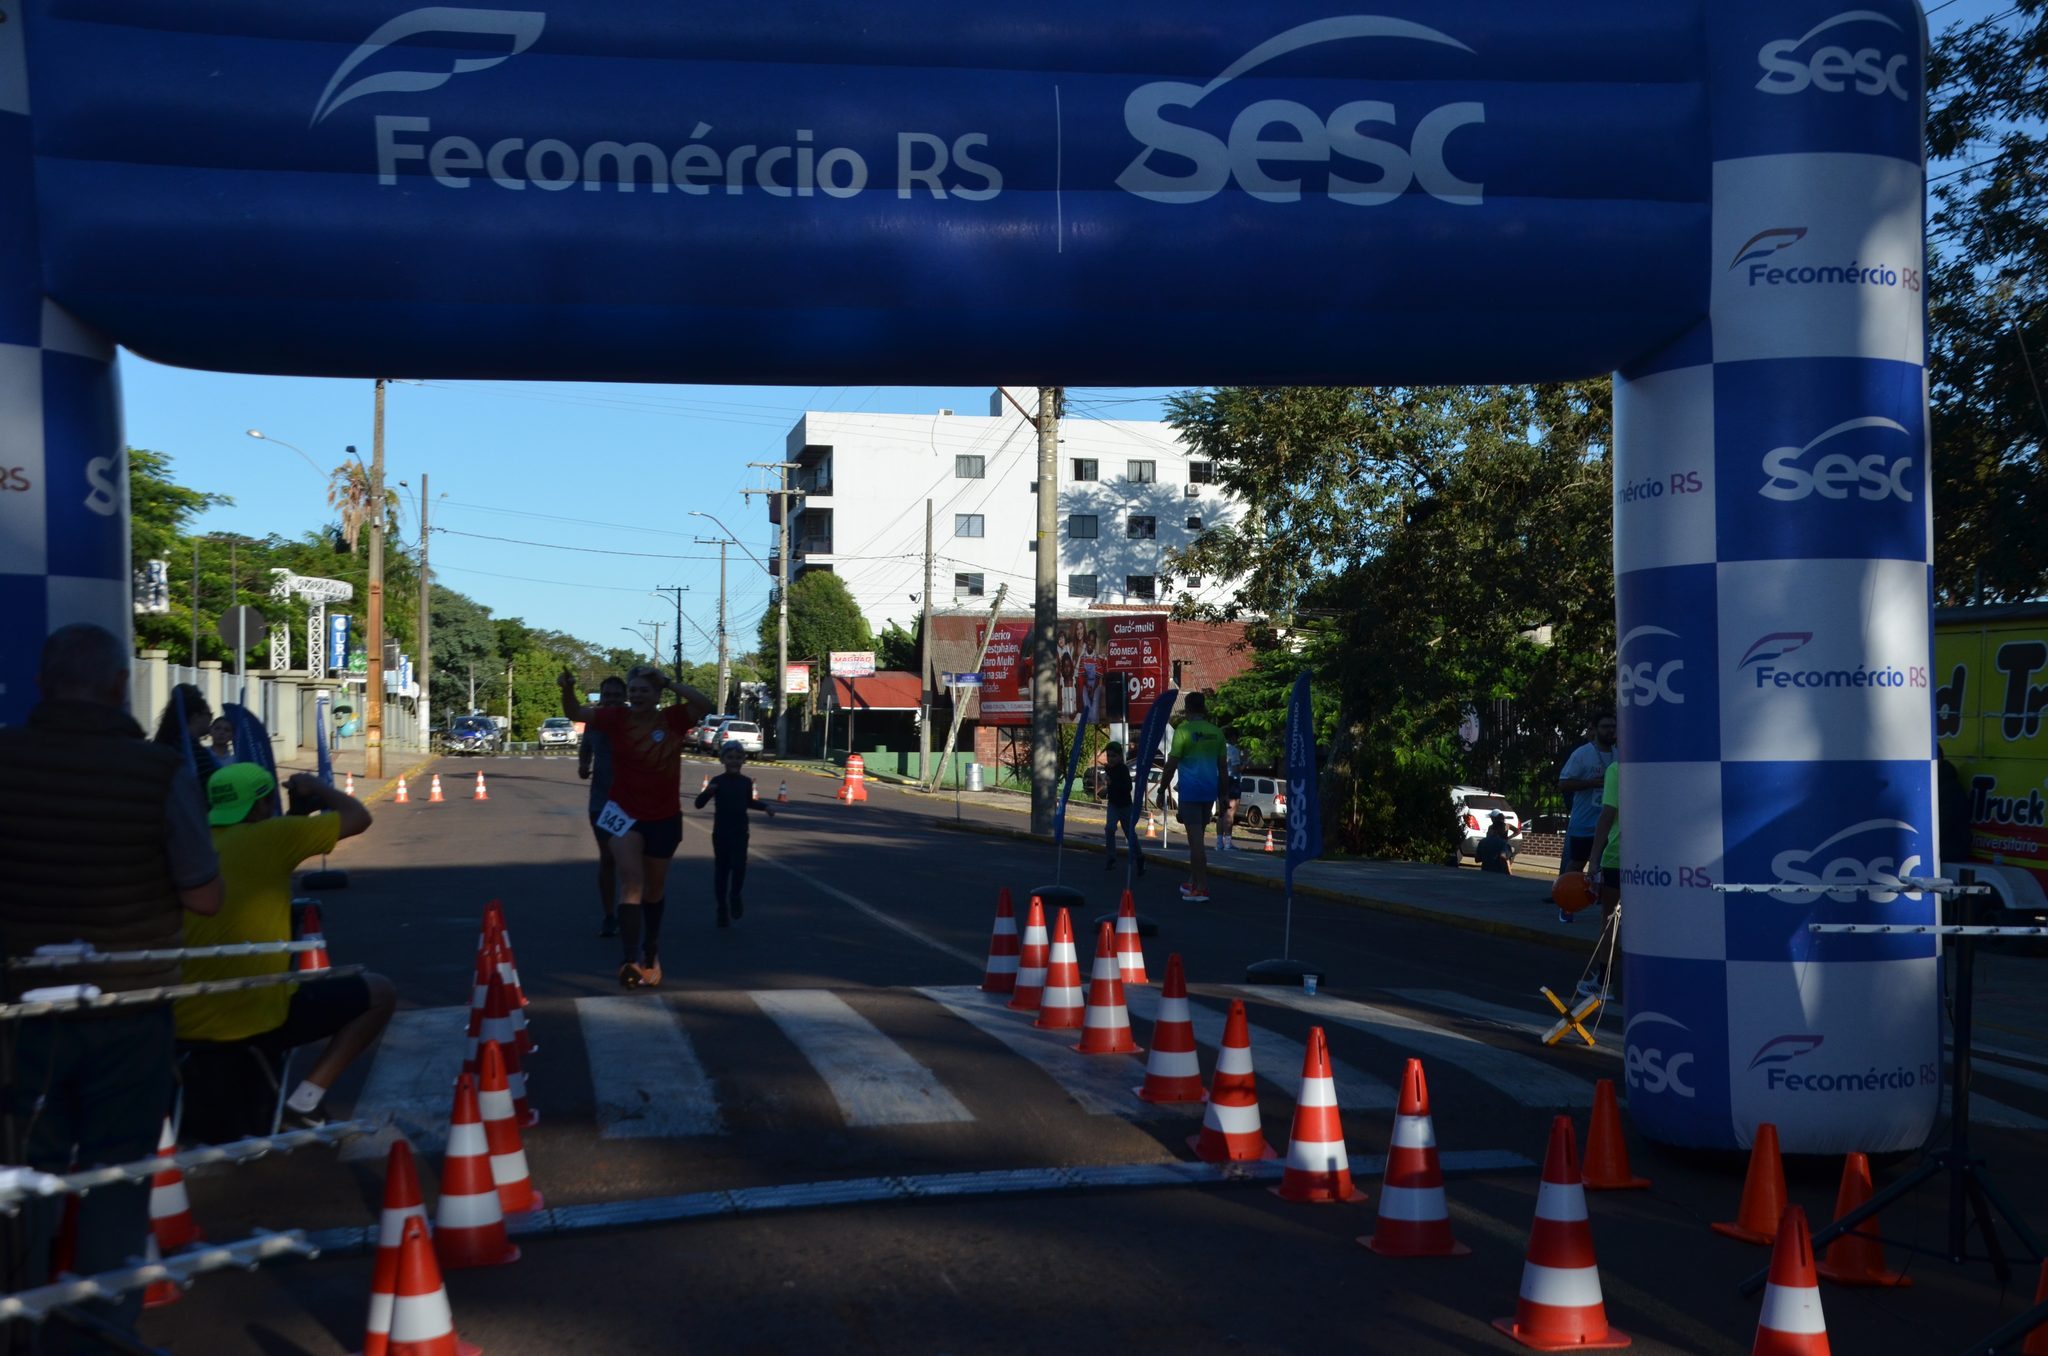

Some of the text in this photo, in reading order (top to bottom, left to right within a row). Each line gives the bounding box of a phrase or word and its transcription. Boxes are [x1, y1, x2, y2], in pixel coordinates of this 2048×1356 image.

[375, 115, 1003, 201] Fecomércio RS
[1749, 261, 1920, 292] Fecomércio RS
[1671, 472, 1703, 495] RS
[1109, 646, 1138, 656] 600 MEGA
[1142, 656, 1158, 664] GIGA
[1143, 646, 1152, 655] 60
[1756, 664, 1927, 689] Fecomércio RS
[1679, 866, 1712, 889] RS
[1769, 1064, 1937, 1092] Fecomércio RS
